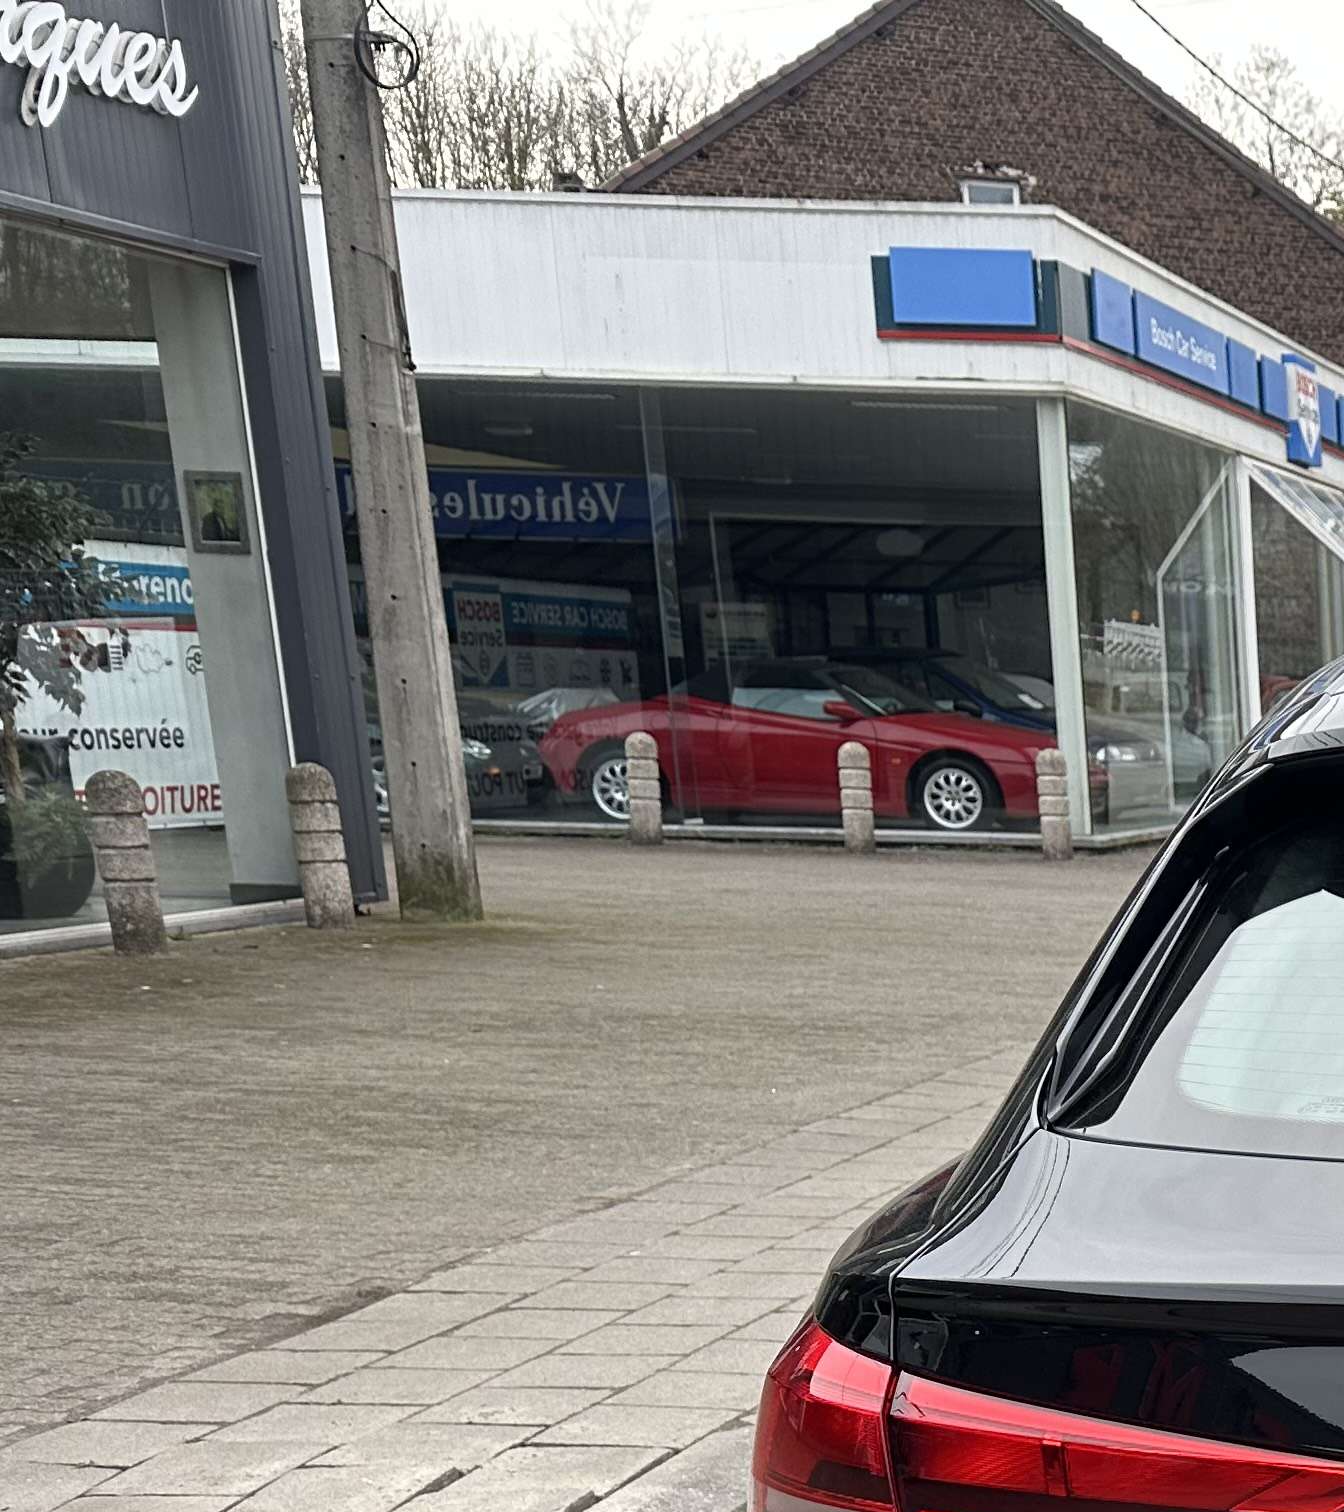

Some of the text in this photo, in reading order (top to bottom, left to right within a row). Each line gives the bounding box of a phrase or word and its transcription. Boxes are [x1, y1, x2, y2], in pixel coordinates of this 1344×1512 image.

[1151, 317, 1217, 371] Bosch Car Service
[69, 718, 185, 751] conservée
[142, 784, 222, 816] OITURE
